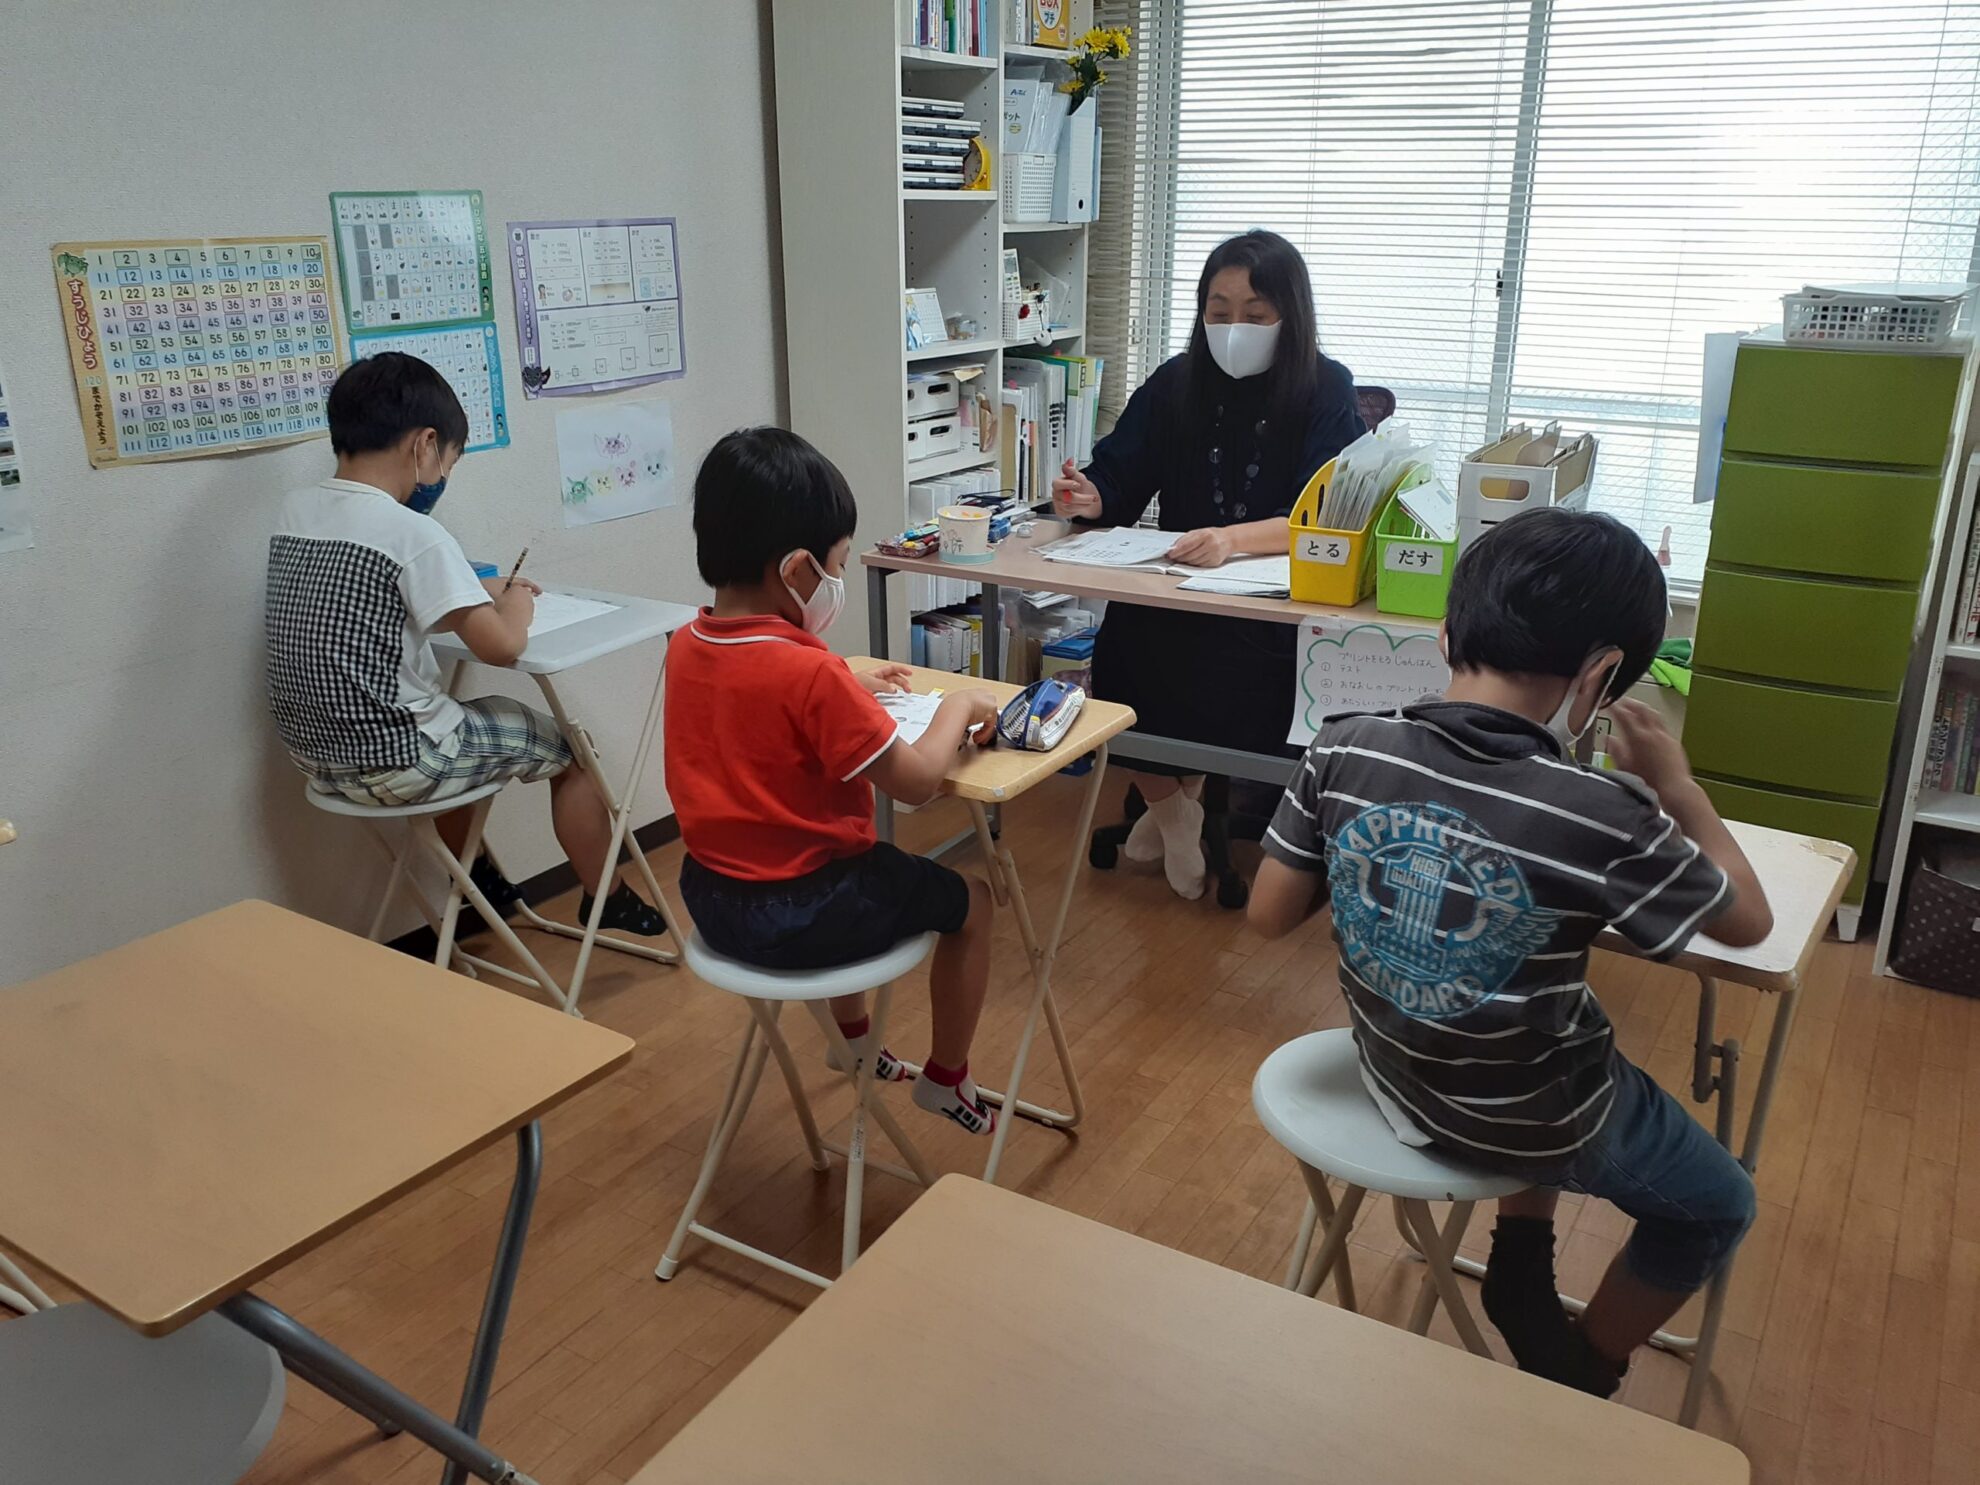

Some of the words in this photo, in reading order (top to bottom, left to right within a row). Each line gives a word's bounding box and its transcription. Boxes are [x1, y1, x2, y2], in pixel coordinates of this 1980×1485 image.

[98, 255, 102, 265] 1
[123, 254, 130, 264] 2
[149, 253, 156, 264] 3
[174, 253, 181, 262] 4
[200, 252, 207, 262] 5
[222, 251, 229, 260] 6
[244, 250, 250, 259] 7
[266, 249, 273, 259] 8
[287, 249, 293, 257] 9
[306, 248, 315, 257] 10
[97, 272, 109, 283] 11
[124, 271, 137, 282] 12
[150, 270, 162, 280] 13
[175, 269, 187, 279] 14
[201, 268, 212, 278] 15
[223, 268, 234, 277] 16
[245, 266, 256, 276] 17
[267, 265, 278, 275] 18
[288, 264, 298, 273] 19
[307, 263, 318, 273] 20
[100, 290, 112, 300] 21
[126, 288, 140, 299] 22
[151, 287, 165, 297] 23
[176, 286, 189, 296] 24
[202, 285, 215, 295] 25
[224, 284, 236, 293] 26
[246, 282, 258, 292] 27
[268, 281, 280, 291] 28
[289, 280, 300, 290] 29
[309, 279, 320, 288] 30
[103, 307, 116, 318] 31
[129, 305, 143, 316] 32
[155, 304, 168, 314] 33
[179, 303, 192, 313] 34
[205, 301, 217, 311] 35
[227, 300, 239, 310] 36
[249, 298, 261, 308] 37
[271, 297, 283, 307] 38
[292, 296, 302, 305] 39
[311, 294, 322, 304] 40
[67, 279, 98, 370] すうじひょう
[107, 324, 119, 334] 41
[133, 322, 146, 332] 42
[158, 321, 171, 331] 43
[182, 320, 195, 329] 44
[208, 318, 220, 327] 45
[230, 316, 242, 326] 46
[253, 314, 263, 324] 47
[274, 313, 284, 322] 48
[294, 311, 304, 320] 49
[313, 310, 325, 319] 50
[110, 341, 122, 352] 51
[136, 339, 149, 350] 52
[160, 337, 174, 348] 53
[184, 336, 198, 346] 54
[209, 334, 222, 344] 55
[232, 332, 245, 342] 56
[254, 330, 266, 340] 57
[276, 328, 287, 338] 58
[296, 326, 306, 336] 59
[315, 325, 327, 334] 60
[113, 358, 126, 368] 61
[139, 356, 152, 366] 62
[164, 354, 177, 364] 63
[188, 352, 201, 362] 64
[212, 350, 225, 360] 65
[234, 348, 247, 358] 66
[258, 345, 268, 356] 67
[279, 343, 290, 353] 68
[298, 342, 308, 351] 69
[317, 340, 328, 349] 70
[116, 375, 129, 385] 71
[141, 372, 155, 383] 72
[166, 370, 180, 380] 73
[190, 368, 203, 378] 74
[214, 366, 228, 376] 75
[237, 364, 250, 373] 76
[259, 361, 271, 371] 77
[281, 359, 292, 368] 78
[300, 357, 310, 366] 79
[319, 355, 331, 365] 80
[120, 392, 132, 402] 81
[144, 389, 158, 400] 82
[169, 386, 183, 397] 83
[193, 384, 206, 394] 84
[218, 382, 230, 392] 85
[240, 380, 253, 390] 86
[262, 377, 274, 387] 87
[283, 375, 294, 384] 88
[302, 372, 312, 382] 89
[321, 370, 333, 379] 90
[122, 408, 134, 419] 91
[147, 405, 161, 416] 92
[171, 403, 185, 413] 93
[196, 401, 209, 410] 94
[220, 398, 233, 407] 95
[242, 395, 255, 405] 96
[265, 392, 276, 402] 97
[286, 390, 296, 399] 98
[304, 387, 315, 397] 99
[122, 424, 139, 435] 101
[148, 421, 166, 432] 102
[172, 418, 190, 429] 103
[197, 416, 213, 426] 104
[220, 413, 237, 424] 105
[244, 410, 260, 421] 106
[266, 407, 280, 418] 107
[286, 405, 300, 415] 108
[305, 402, 318, 412] 109
[124, 440, 141, 451] 111
[150, 437, 168, 448] 112
[175, 434, 193, 445] 113
[199, 432, 216, 442] 114
[223, 428, 240, 439] 115
[246, 426, 263, 436] 116
[268, 422, 283, 433] 117
[288, 420, 302, 430] 118
[307, 416, 320, 426] 119
[1306, 540, 1340, 558] とる
[1398, 548, 1434, 567] だす
[1410, 854, 1442, 880] HIGH
[1390, 866, 1439, 896] QUALITY
